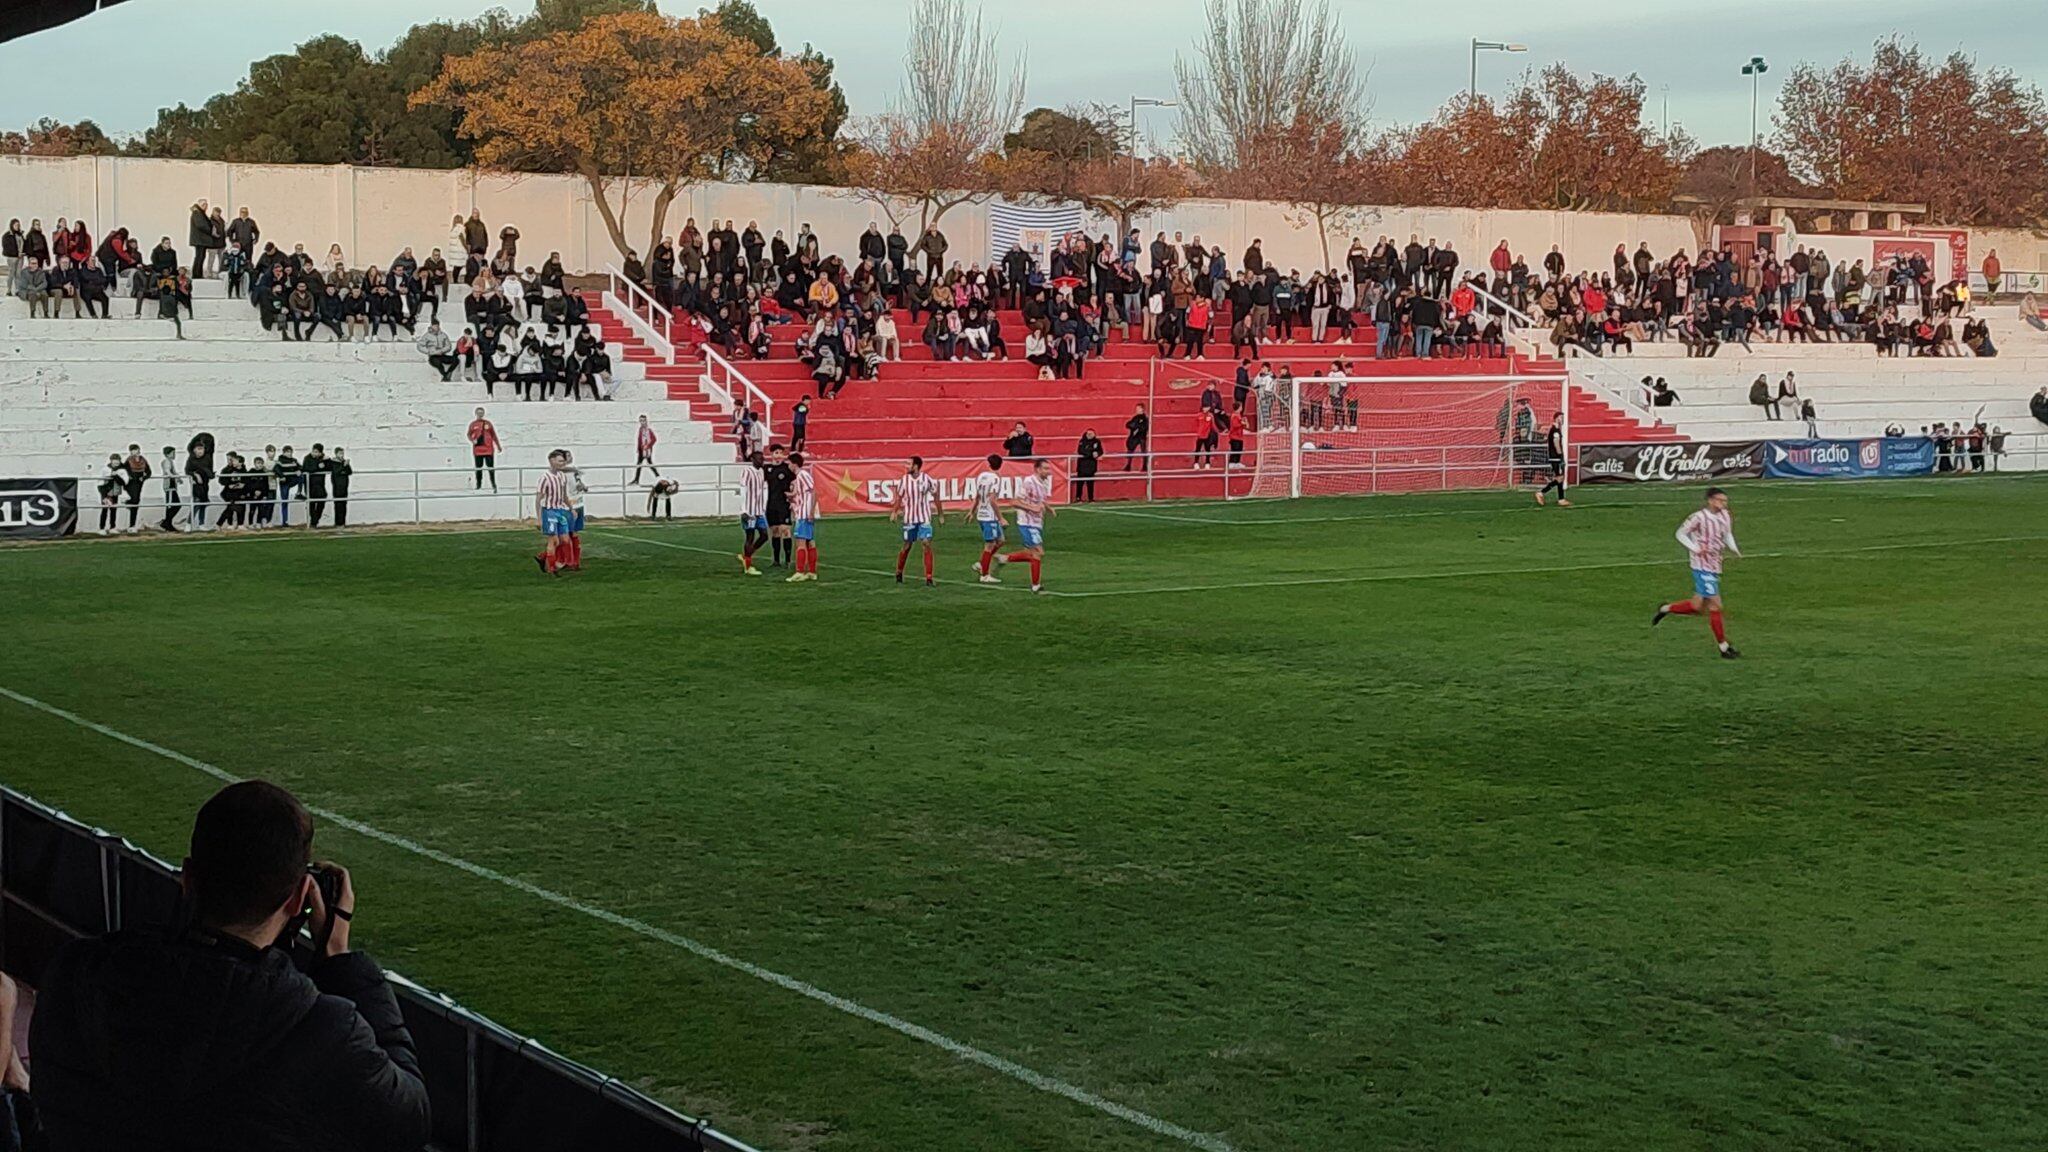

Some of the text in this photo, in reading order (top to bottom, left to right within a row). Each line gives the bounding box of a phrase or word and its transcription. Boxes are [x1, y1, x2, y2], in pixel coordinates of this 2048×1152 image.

[1593, 457, 1624, 473] cafés
[1658, 444, 1713, 481] Criollo
[0, 492, 58, 524] TS
